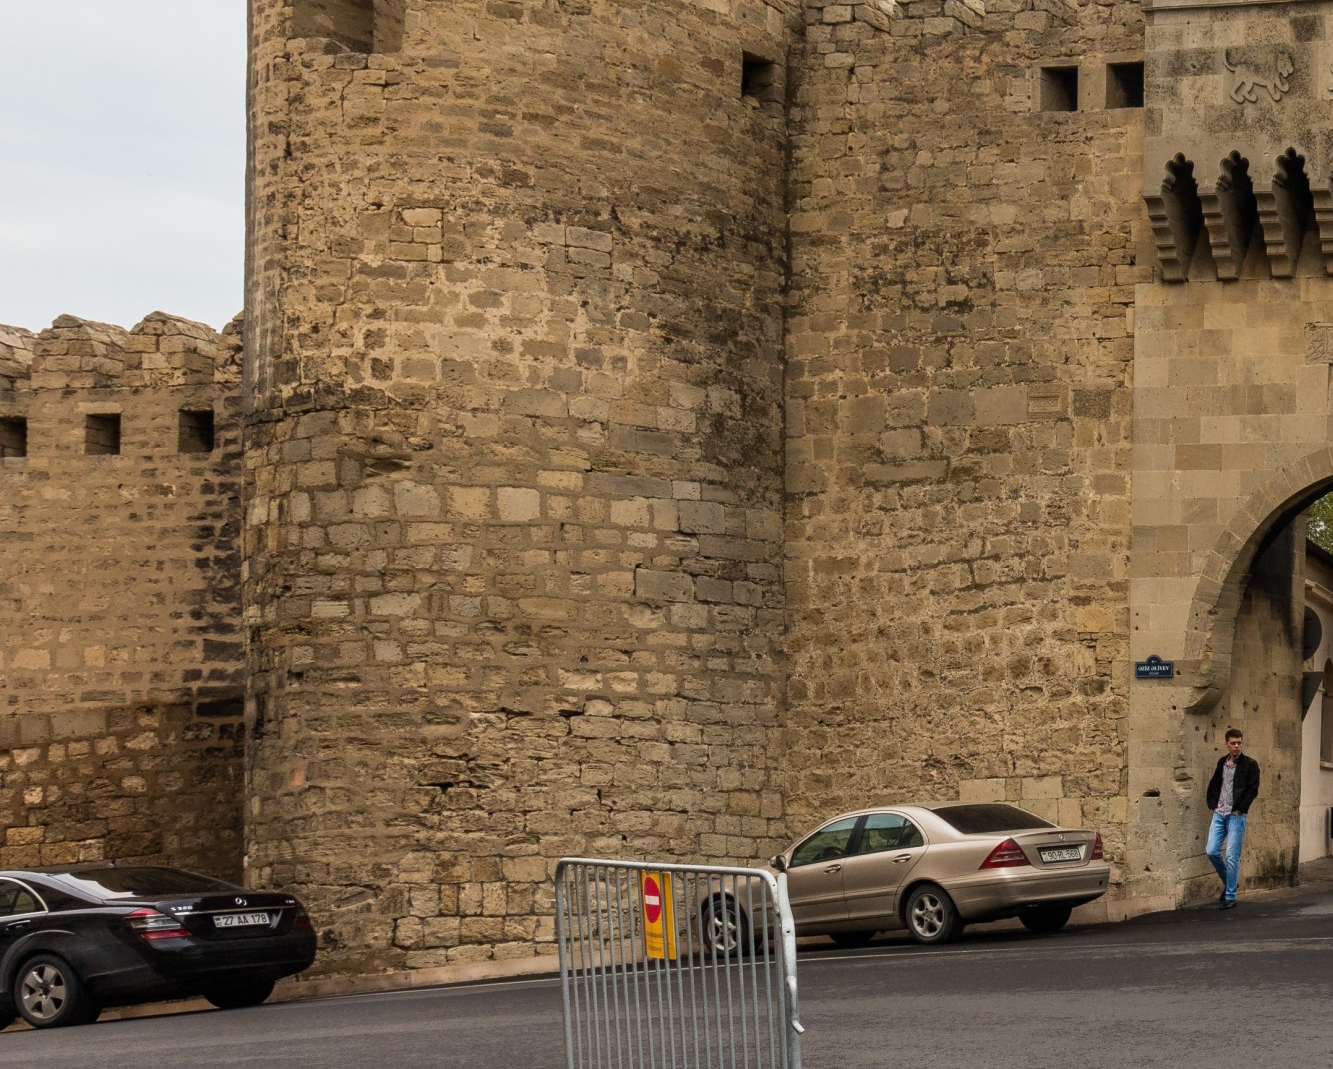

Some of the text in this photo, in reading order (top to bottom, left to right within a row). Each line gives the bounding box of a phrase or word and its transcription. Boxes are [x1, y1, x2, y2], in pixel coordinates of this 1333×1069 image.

[222, 914, 267, 926] 27 AA 178
